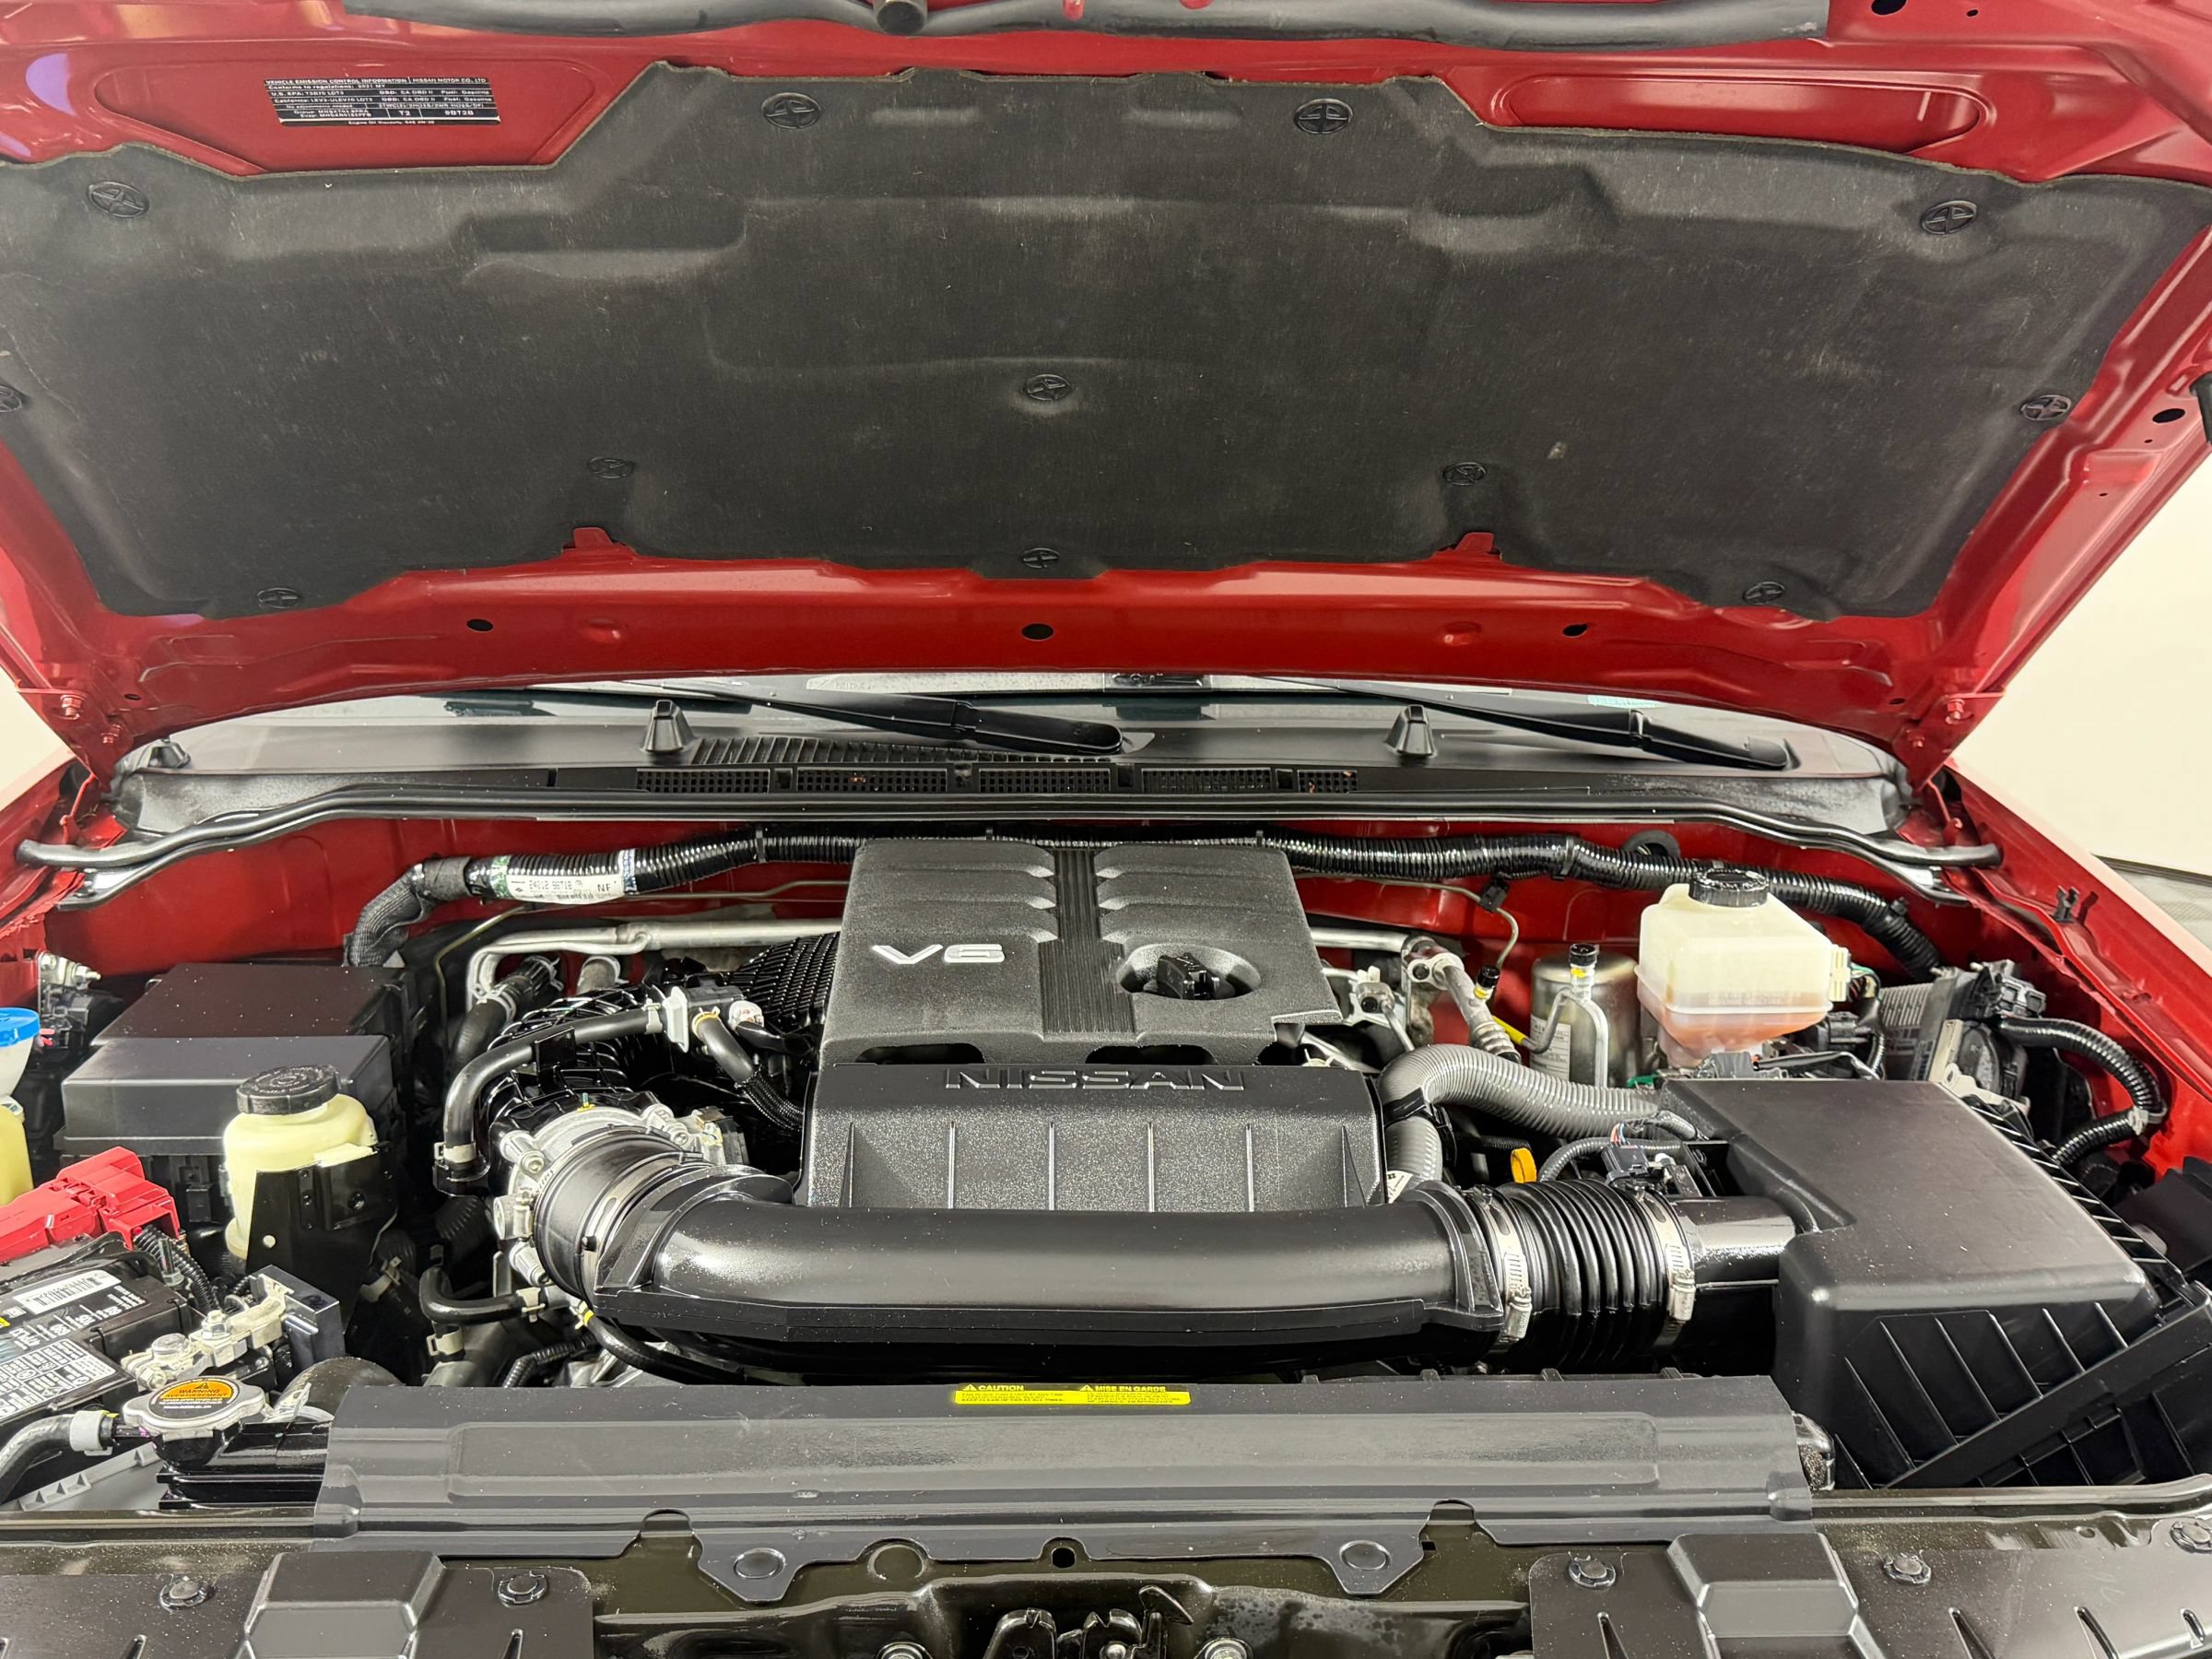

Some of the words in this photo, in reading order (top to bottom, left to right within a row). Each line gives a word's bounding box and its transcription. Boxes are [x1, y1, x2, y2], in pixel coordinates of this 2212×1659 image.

[597, 883, 612, 892] NF
[870, 943, 1005, 965] V6
[945, 1066, 1246, 1091] NISSAN
